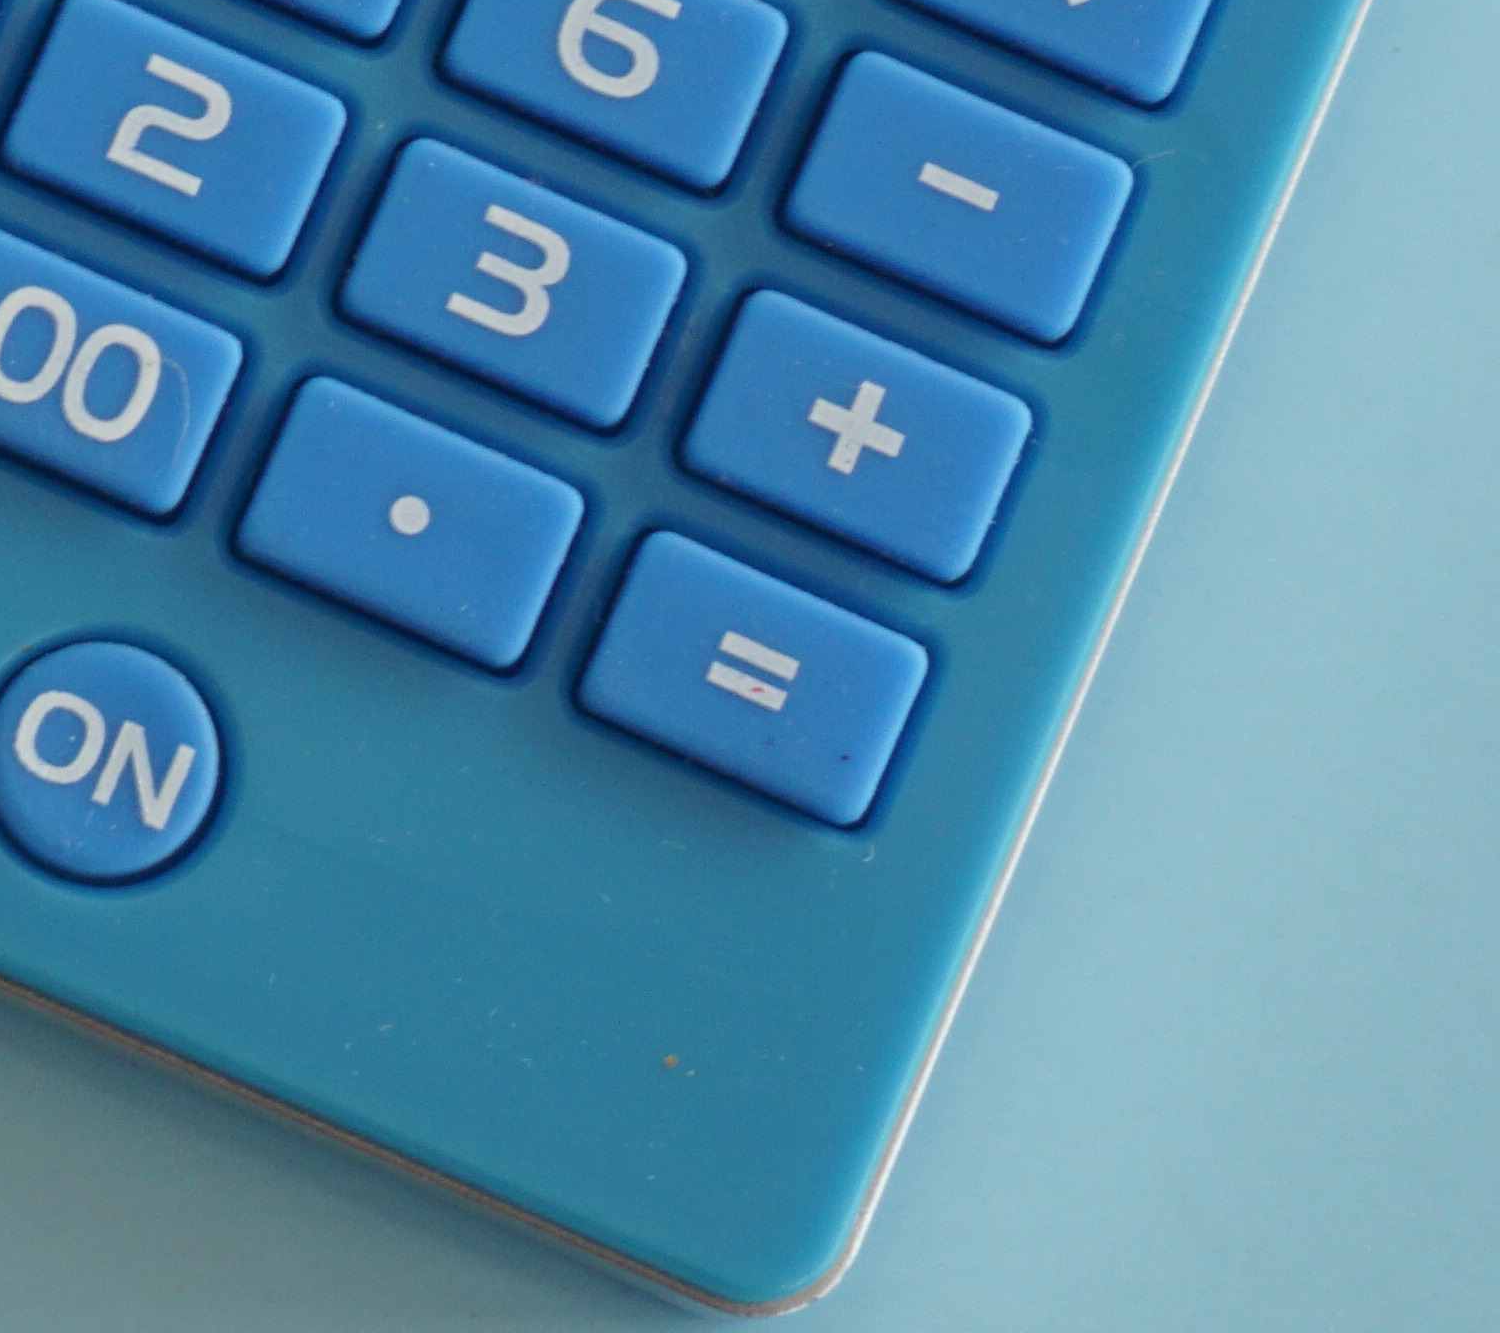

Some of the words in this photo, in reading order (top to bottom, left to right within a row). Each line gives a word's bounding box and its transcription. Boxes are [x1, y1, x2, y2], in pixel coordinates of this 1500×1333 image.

[106, 53, 232, 197] 2
[446, 204, 570, 337] 3
[13, 690, 195, 831] ON
